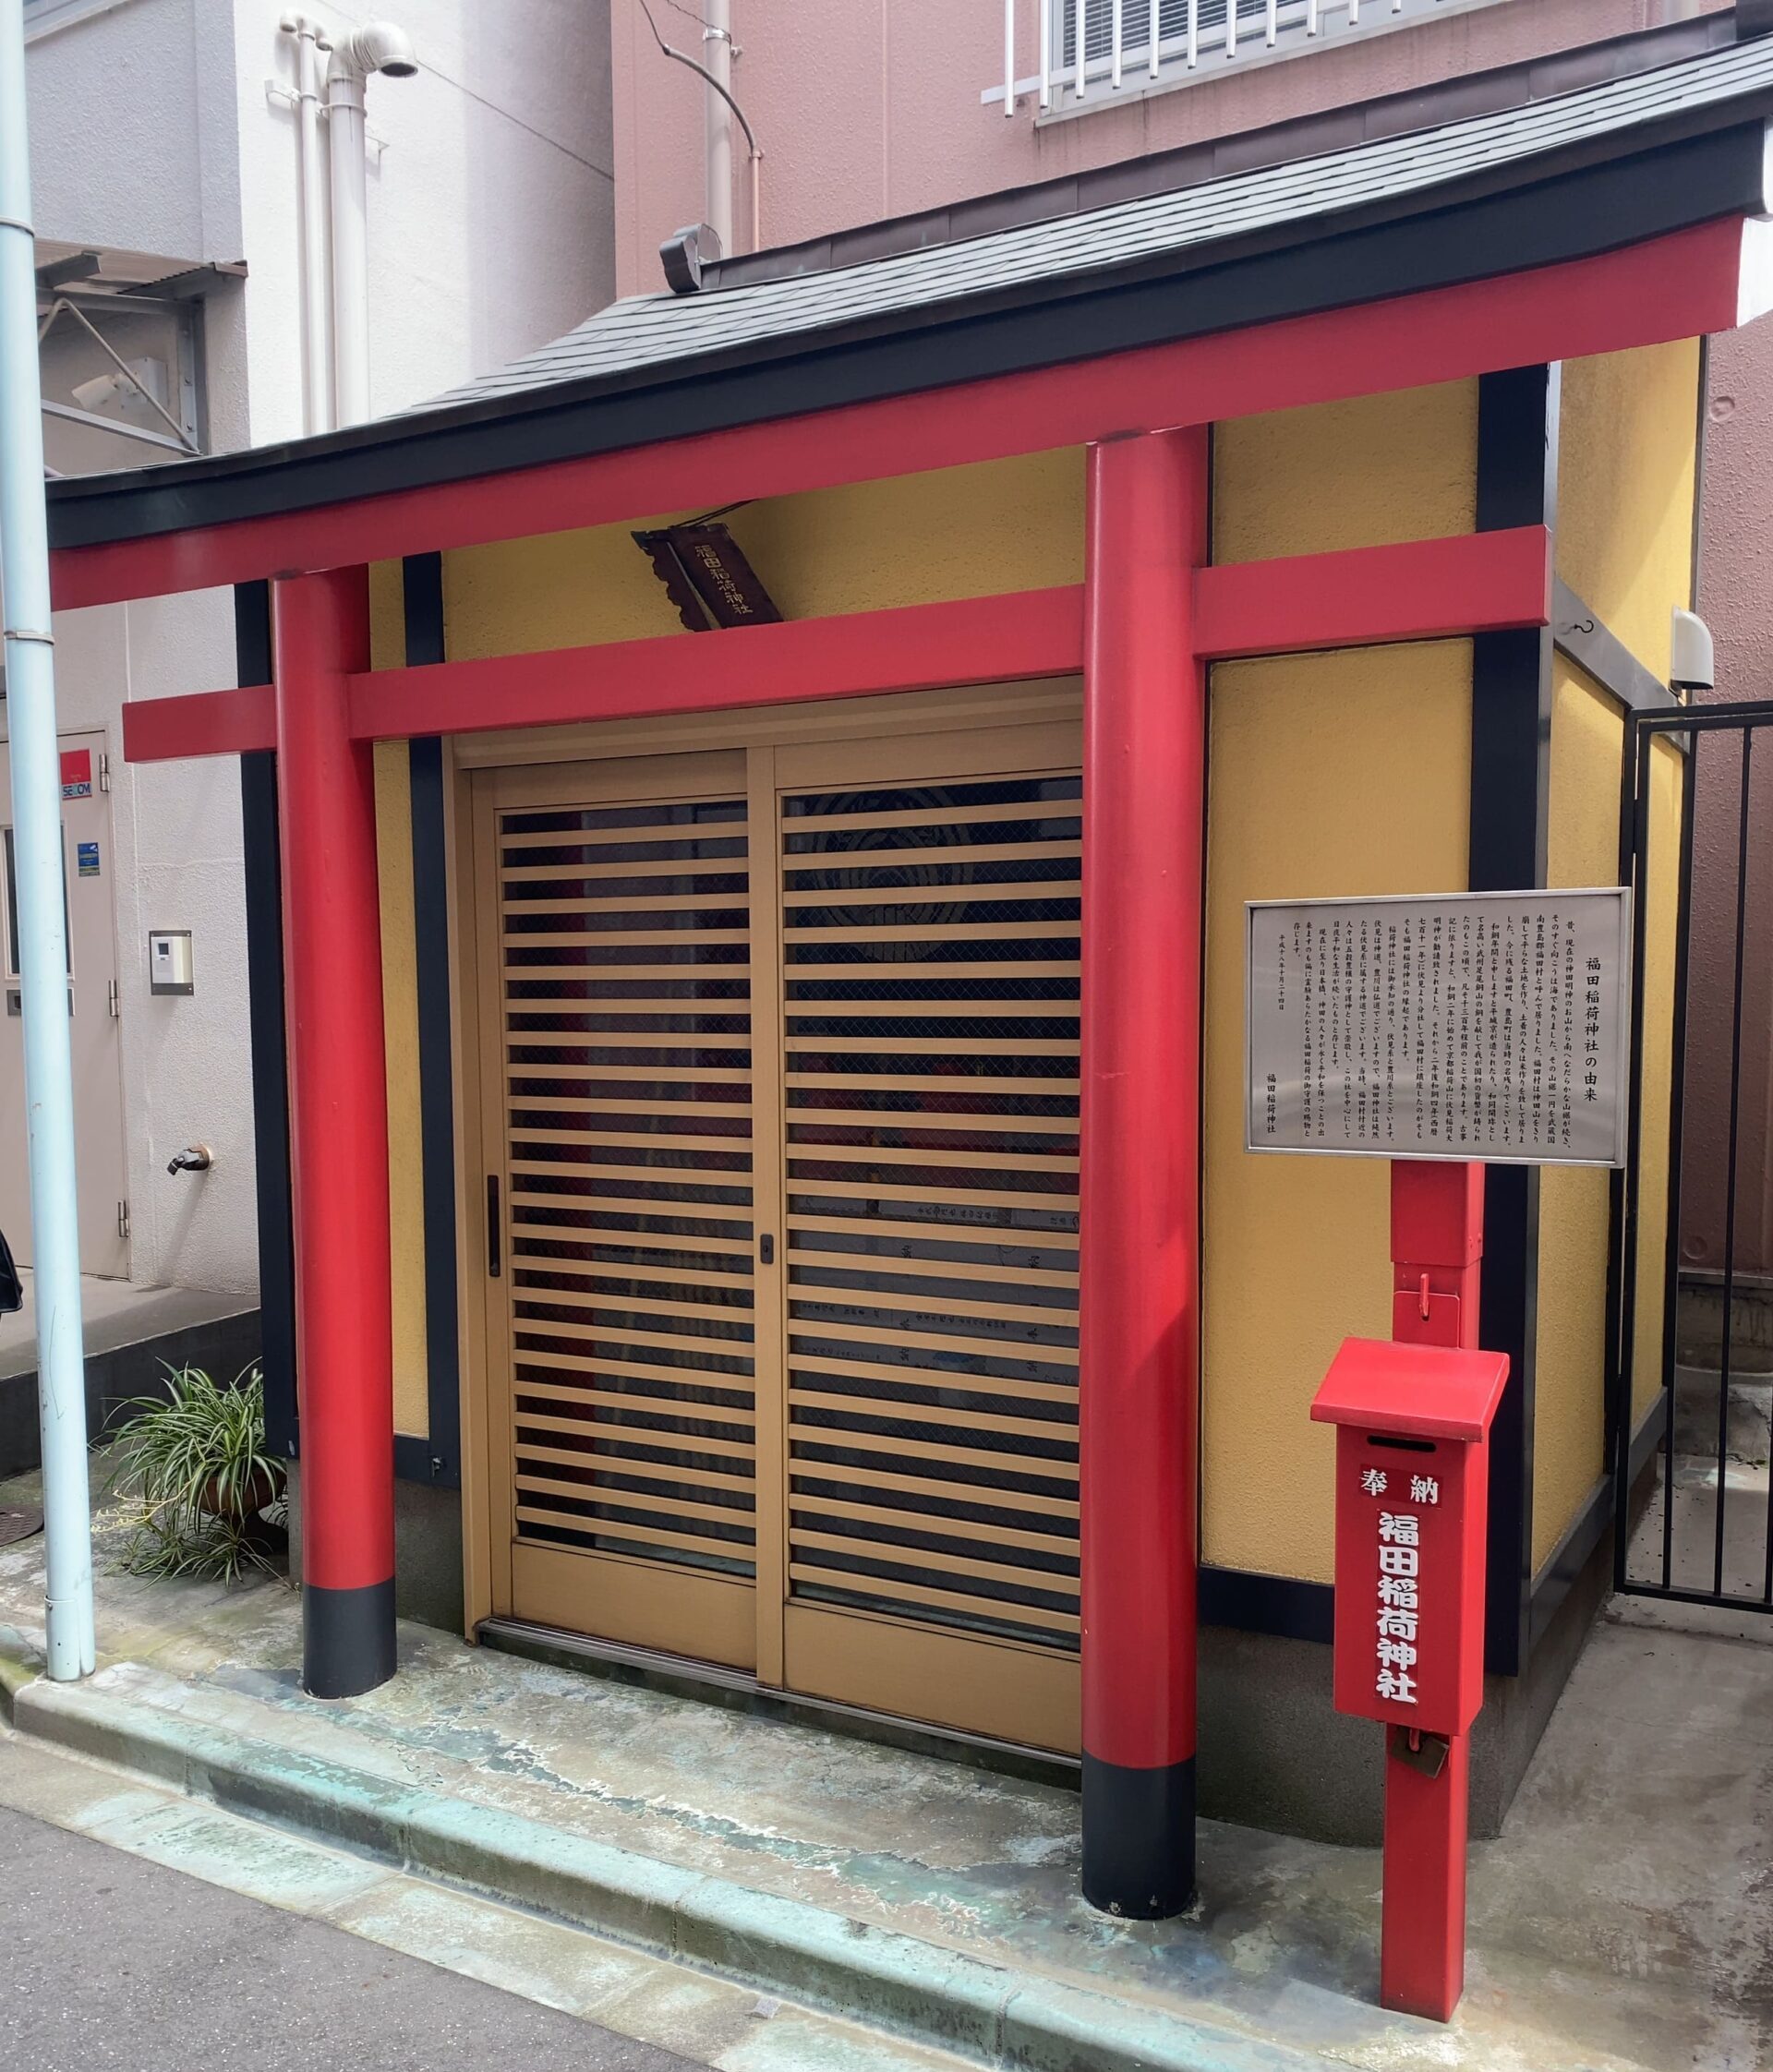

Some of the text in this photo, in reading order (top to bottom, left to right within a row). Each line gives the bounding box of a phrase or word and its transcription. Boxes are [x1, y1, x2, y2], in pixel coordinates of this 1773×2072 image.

[1584, 958, 1600, 1102] 福田稲荷神社の由来
[1267, 1074, 1276, 1133] 福田稲荷神社
[1359, 1468, 1440, 1505] 奉納
[1375, 1512, 1419, 1705] 福田稲荷神社
